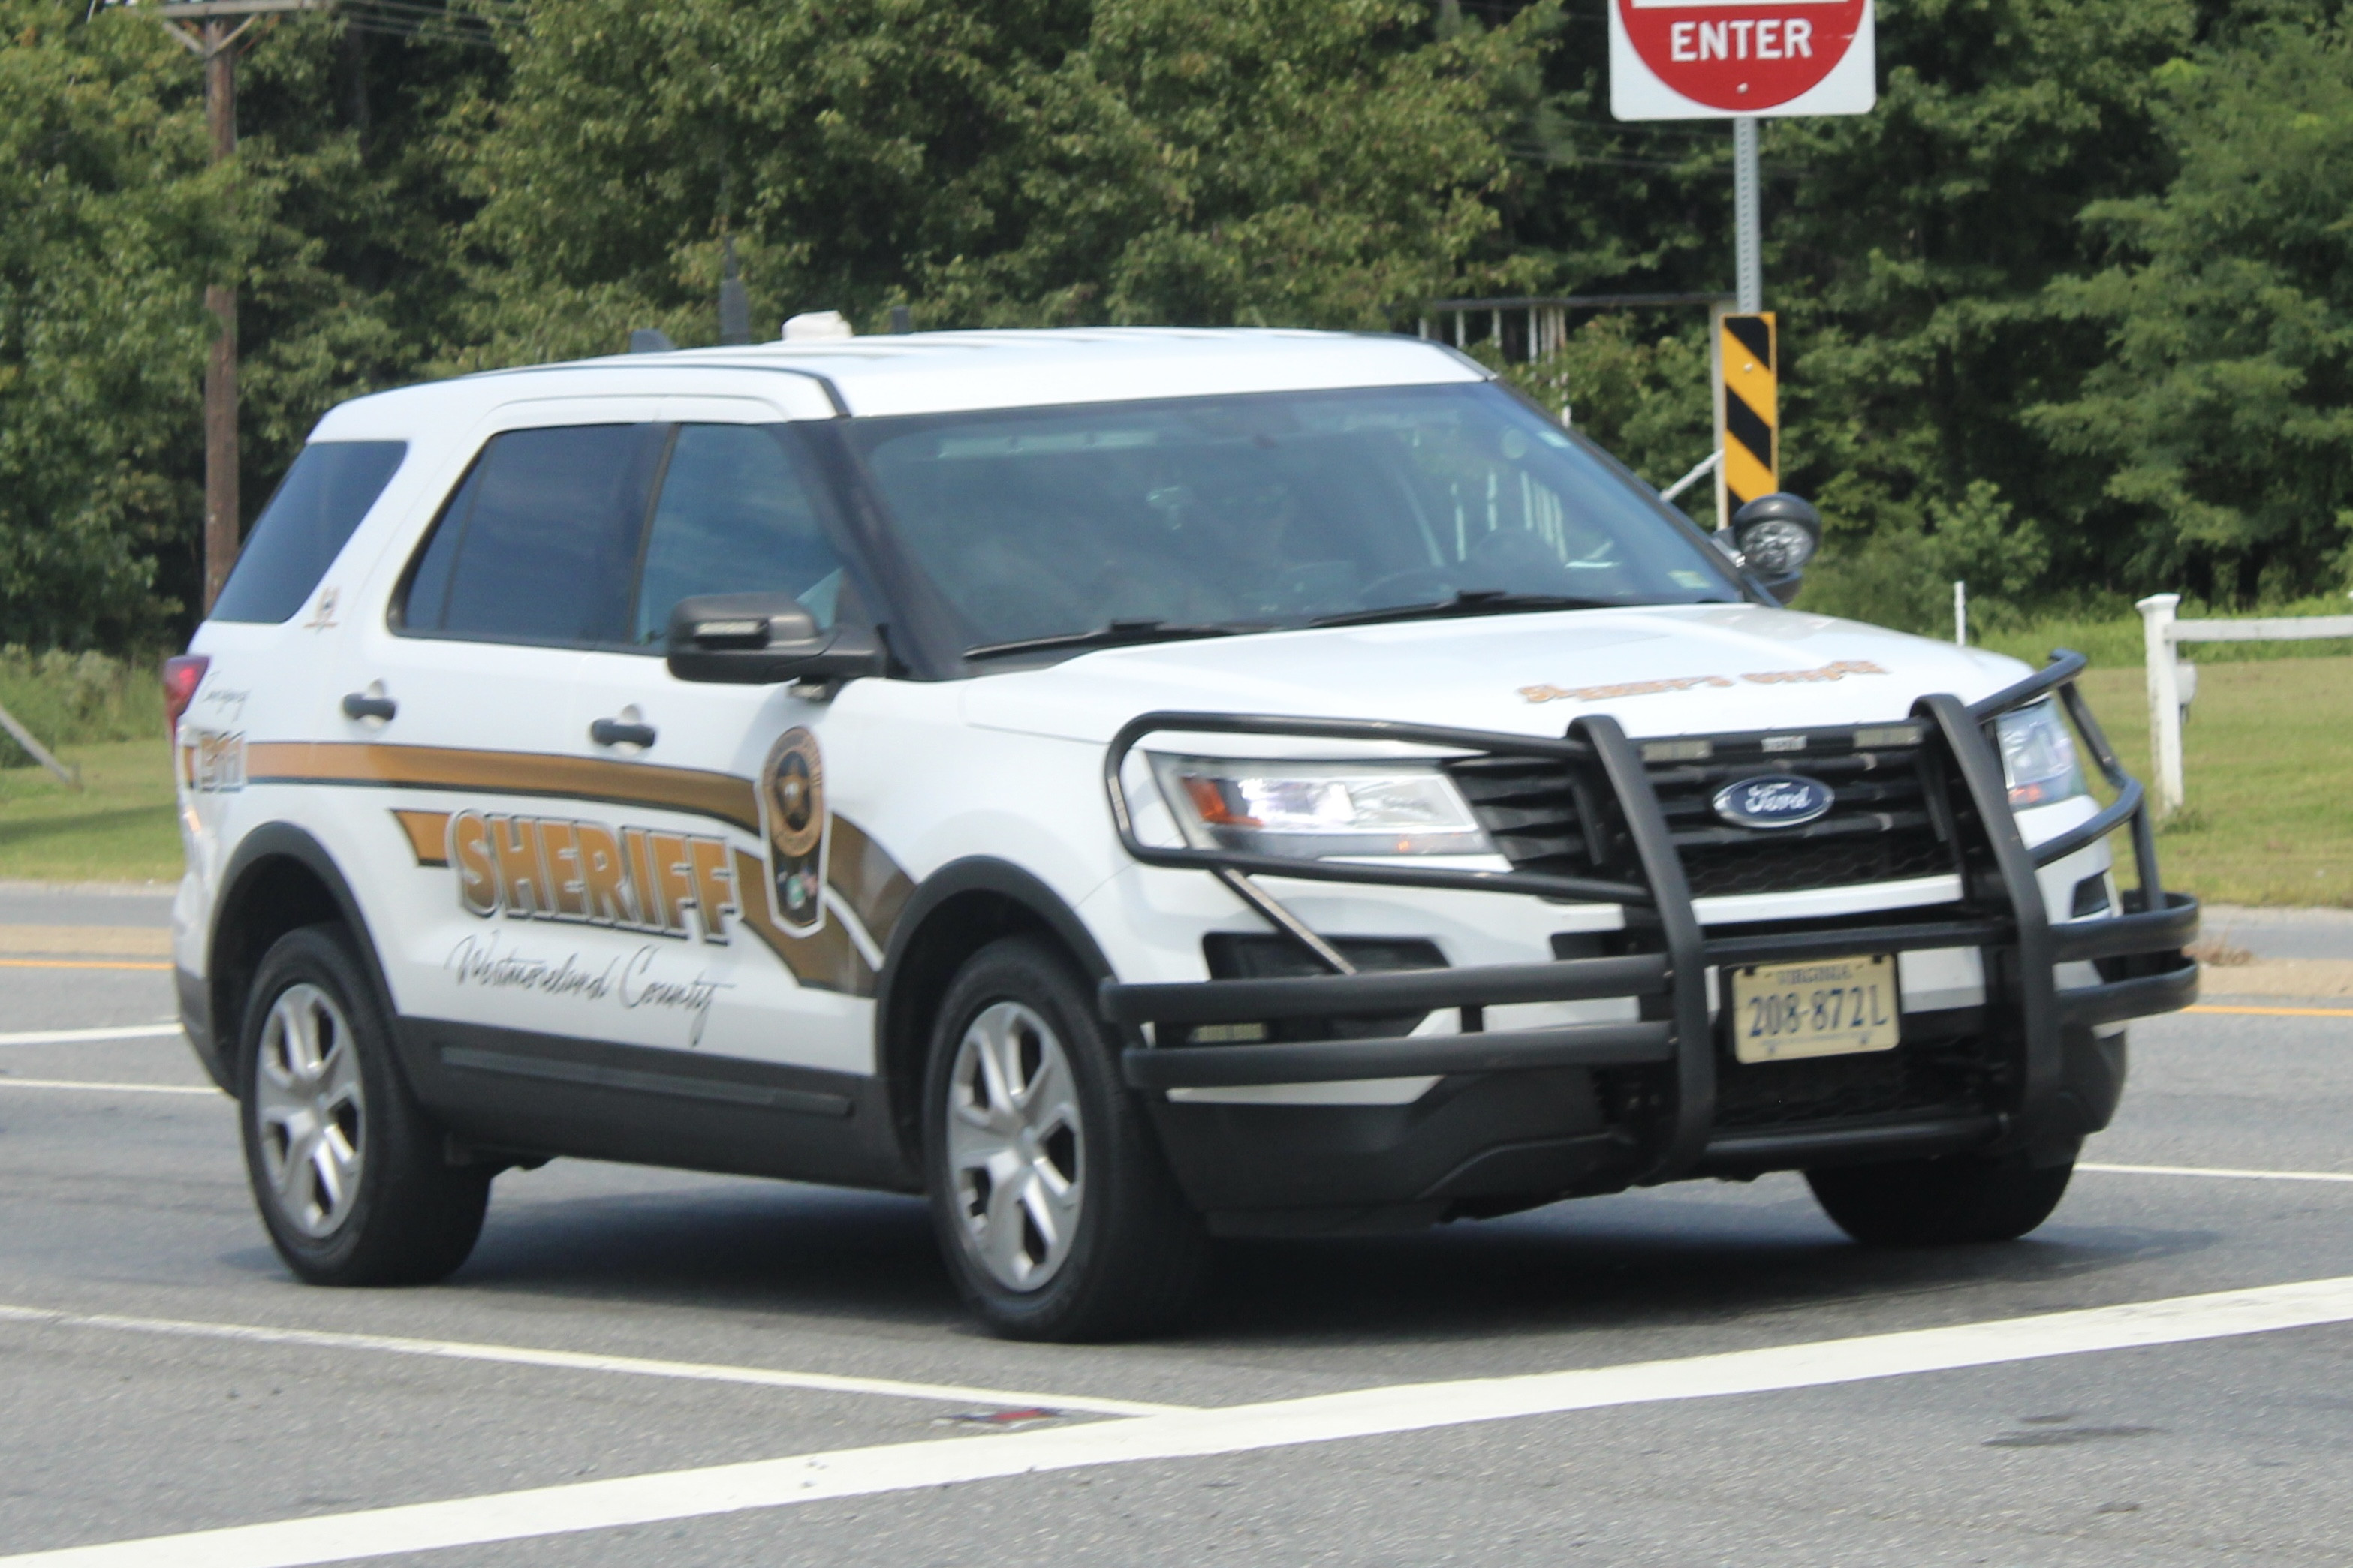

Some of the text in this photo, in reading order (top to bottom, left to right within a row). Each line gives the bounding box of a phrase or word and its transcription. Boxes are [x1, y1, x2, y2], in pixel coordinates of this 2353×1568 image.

[1671, 18, 1812, 62] ENTER
[1744, 782, 1812, 814] Ford
[447, 808, 742, 946] SHERIFF
[618, 944, 738, 1048] County
[1749, 984, 1888, 1037] 208-872L
